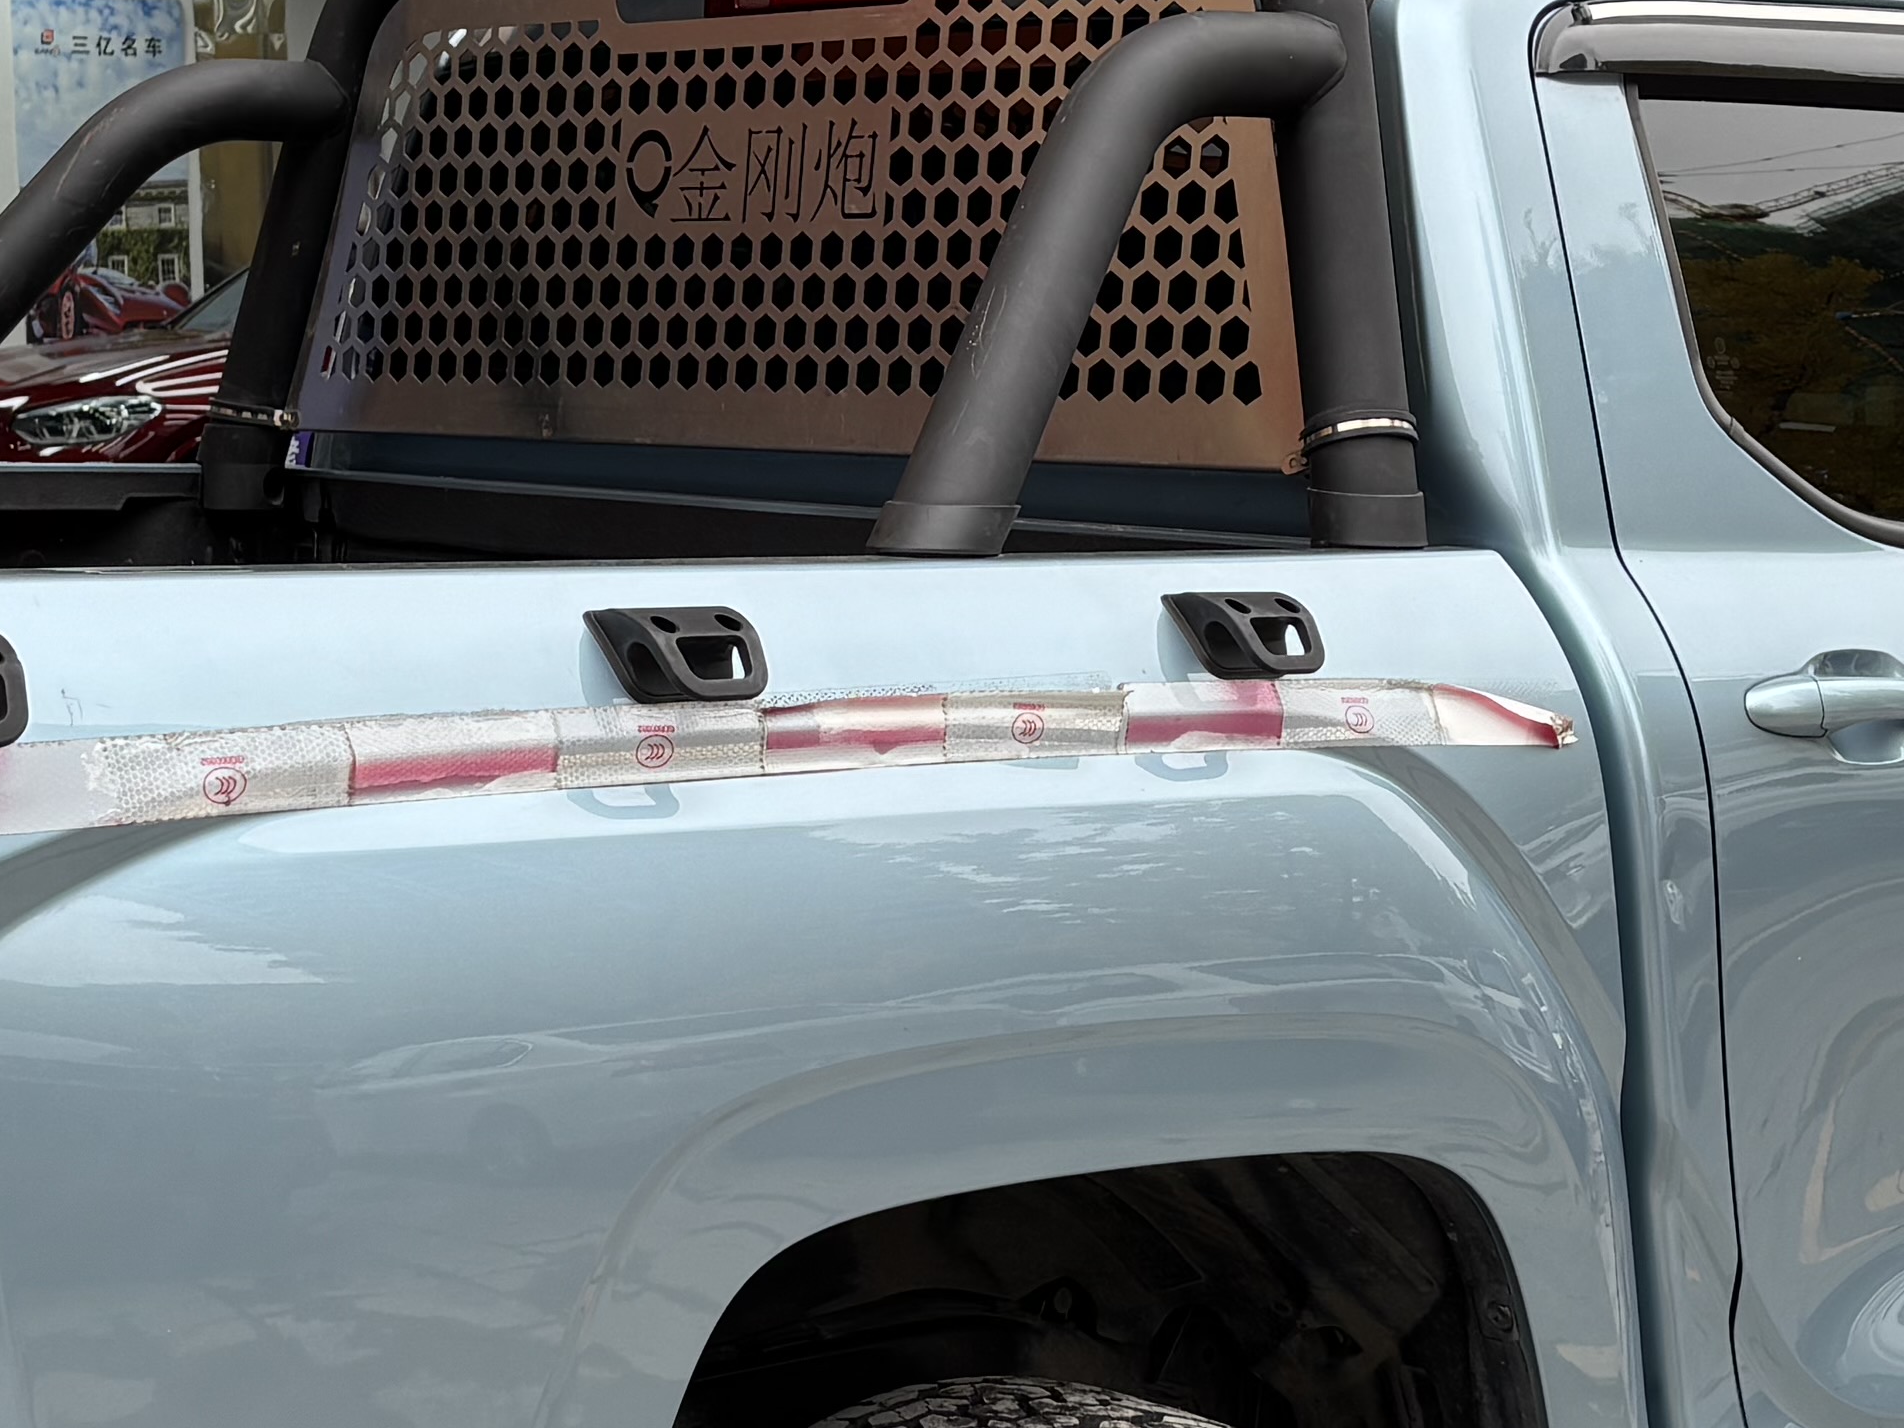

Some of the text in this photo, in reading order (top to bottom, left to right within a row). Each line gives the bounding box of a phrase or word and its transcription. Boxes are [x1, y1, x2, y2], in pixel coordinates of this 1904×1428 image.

[71, 35, 163, 58] 三亿名车
[670, 117, 879, 223] 金刚炮
